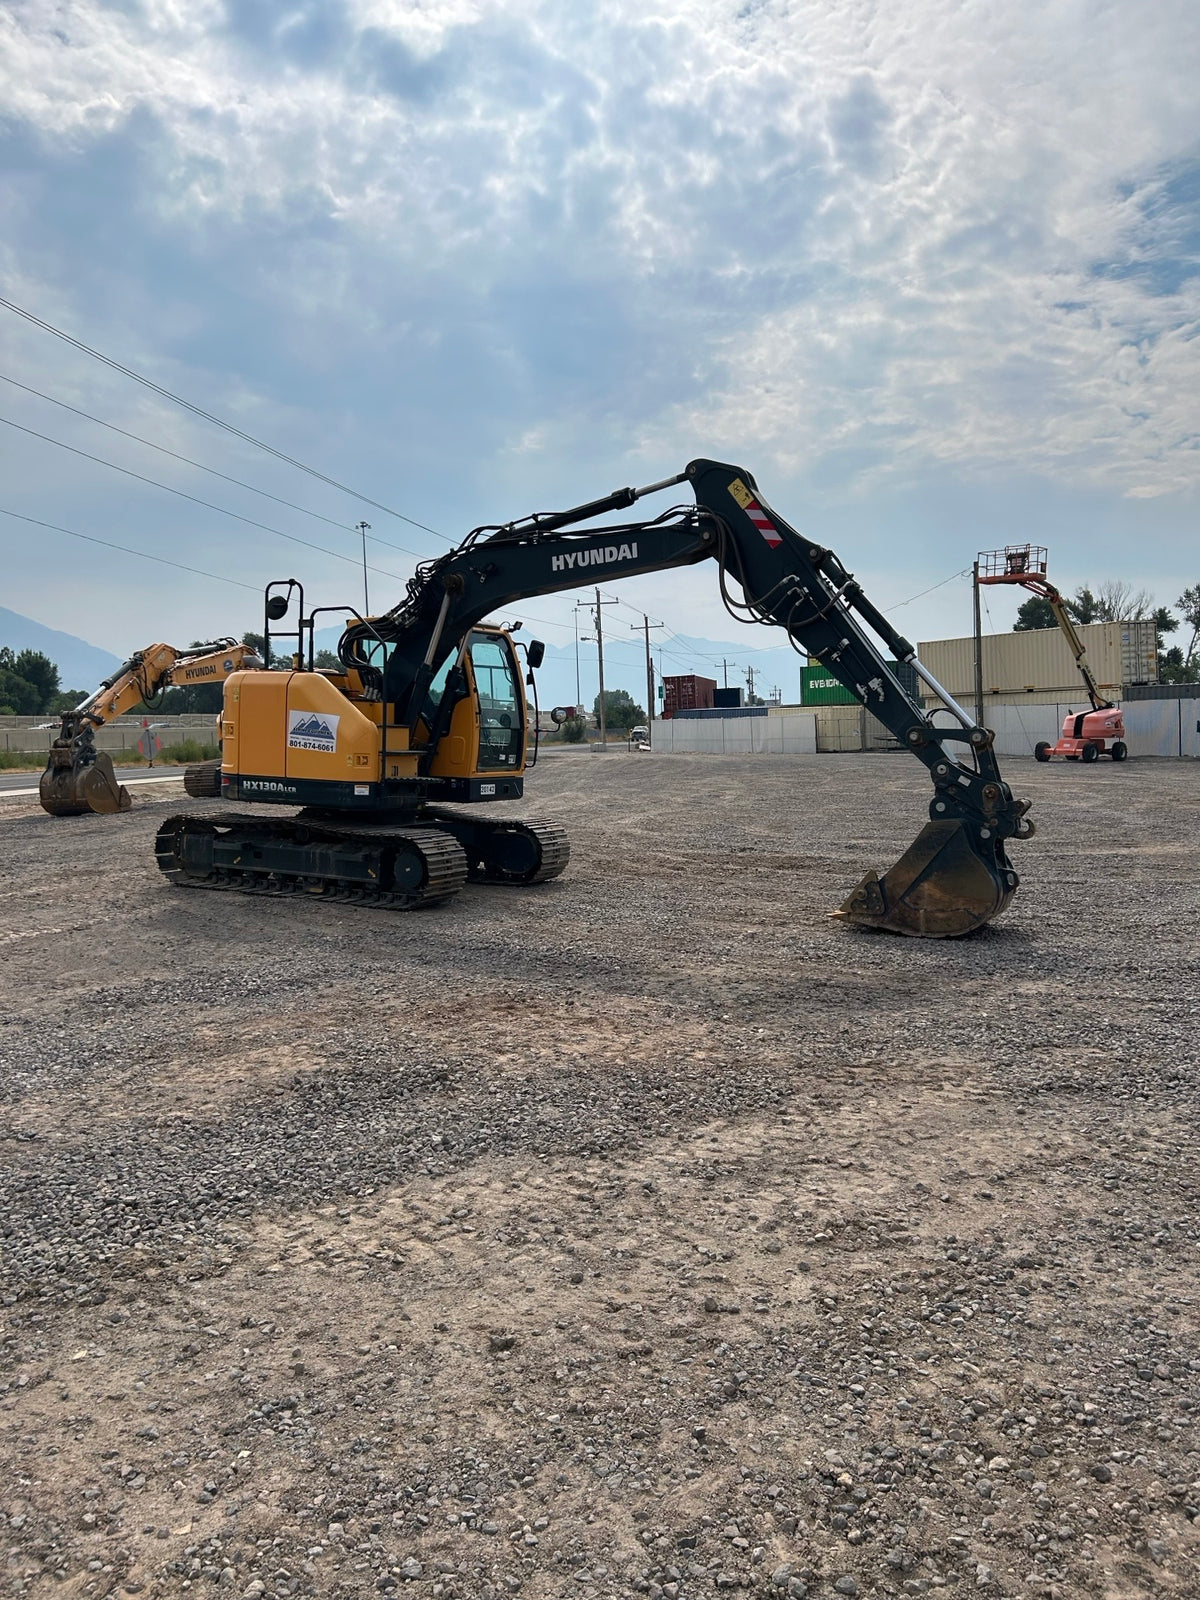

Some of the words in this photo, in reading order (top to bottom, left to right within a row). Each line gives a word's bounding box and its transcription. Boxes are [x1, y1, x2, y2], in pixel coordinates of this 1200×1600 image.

[551, 542, 639, 571] HYUNDAI
[185, 664, 217, 679] HYUNDAI
[289, 739, 334, 752] 801-874-6061
